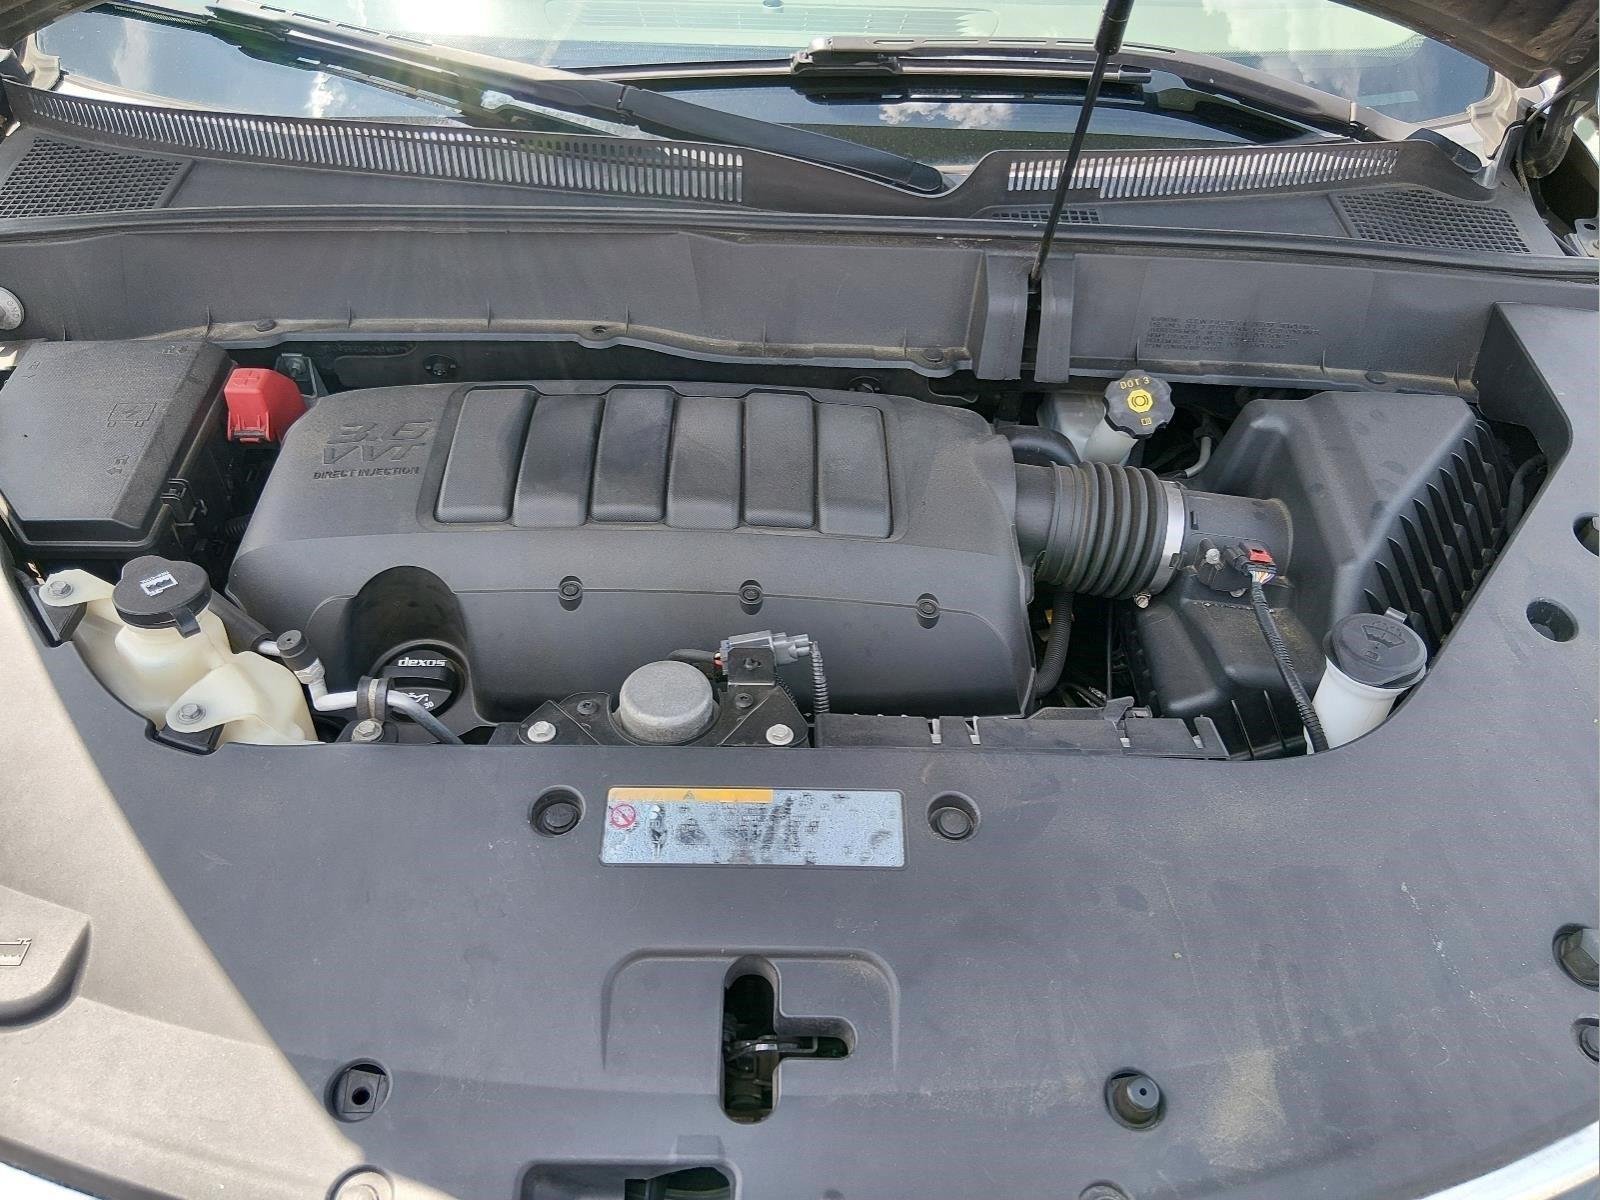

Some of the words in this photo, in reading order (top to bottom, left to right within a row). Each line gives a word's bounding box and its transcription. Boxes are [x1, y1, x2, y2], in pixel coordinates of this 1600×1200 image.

[1120, 378, 1140, 390] DOT
[1142, 376, 1150, 385] 3
[327, 419, 433, 444] 3.6
[322, 441, 427, 465] VVT
[313, 469, 357, 480] DIRECT
[359, 466, 420, 477] INJECTION
[398, 656, 448, 667] dexos
